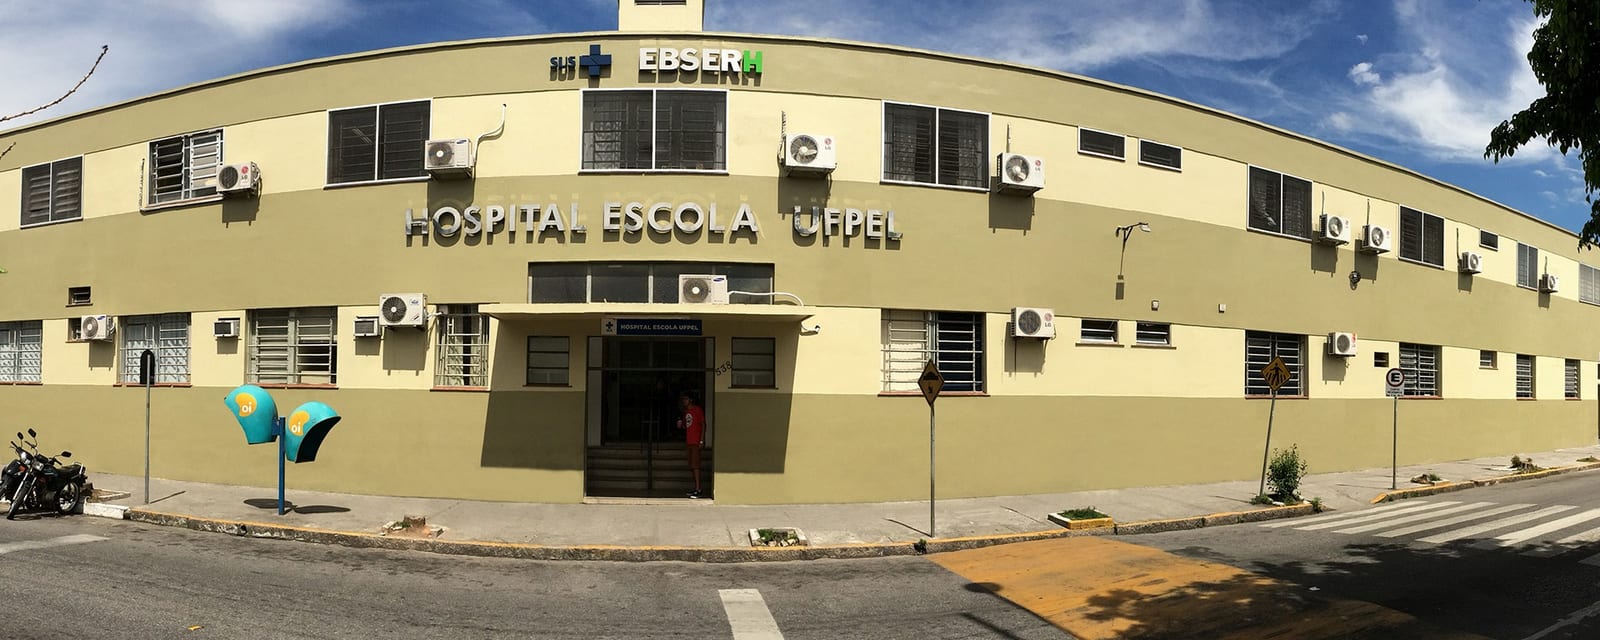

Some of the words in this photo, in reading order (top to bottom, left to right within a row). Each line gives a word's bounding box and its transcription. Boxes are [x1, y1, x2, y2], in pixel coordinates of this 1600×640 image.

[638, 47, 763, 73] EBSERH
[405, 202, 587, 237] HOSPITAL
[603, 201, 759, 234] ESCOLA
[793, 205, 903, 241] UFPEL
[1391, 373, 1400, 382] E
